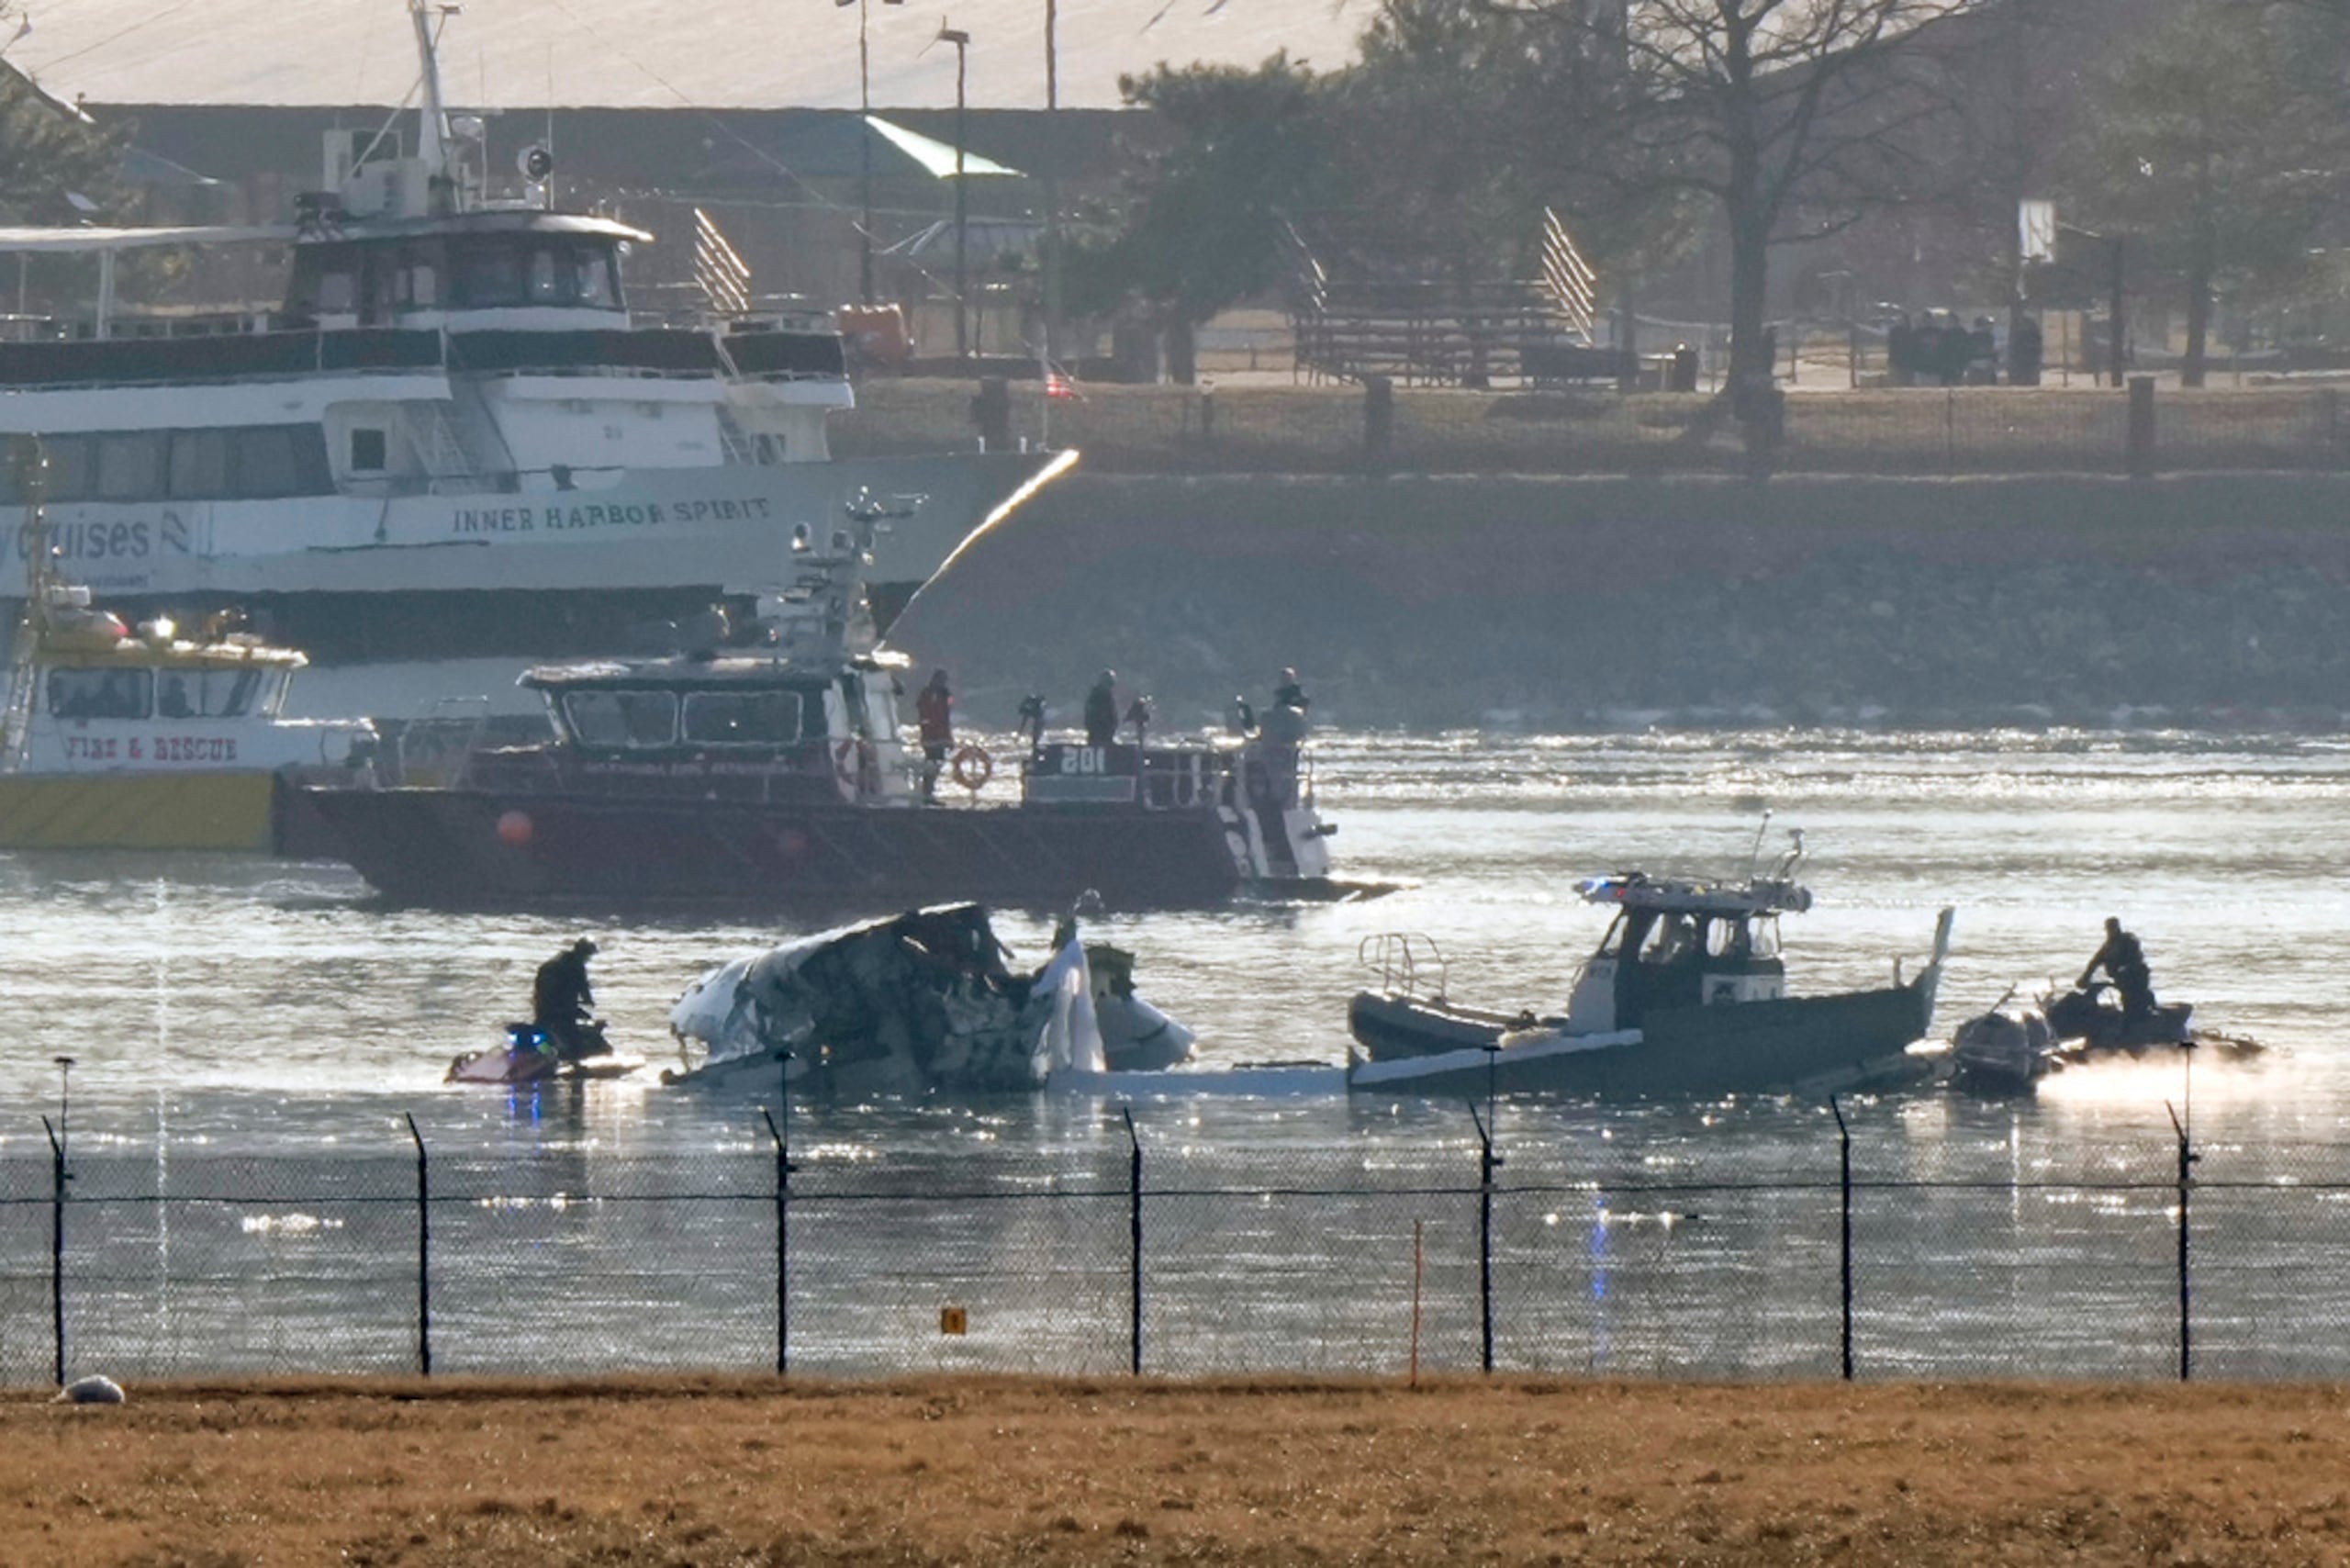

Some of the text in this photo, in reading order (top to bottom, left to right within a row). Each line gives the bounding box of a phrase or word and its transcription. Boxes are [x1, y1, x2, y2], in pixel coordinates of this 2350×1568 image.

[453, 497, 773, 532] INNER HARBOR SPIRIT
[153, 736, 238, 762] RESCUE
